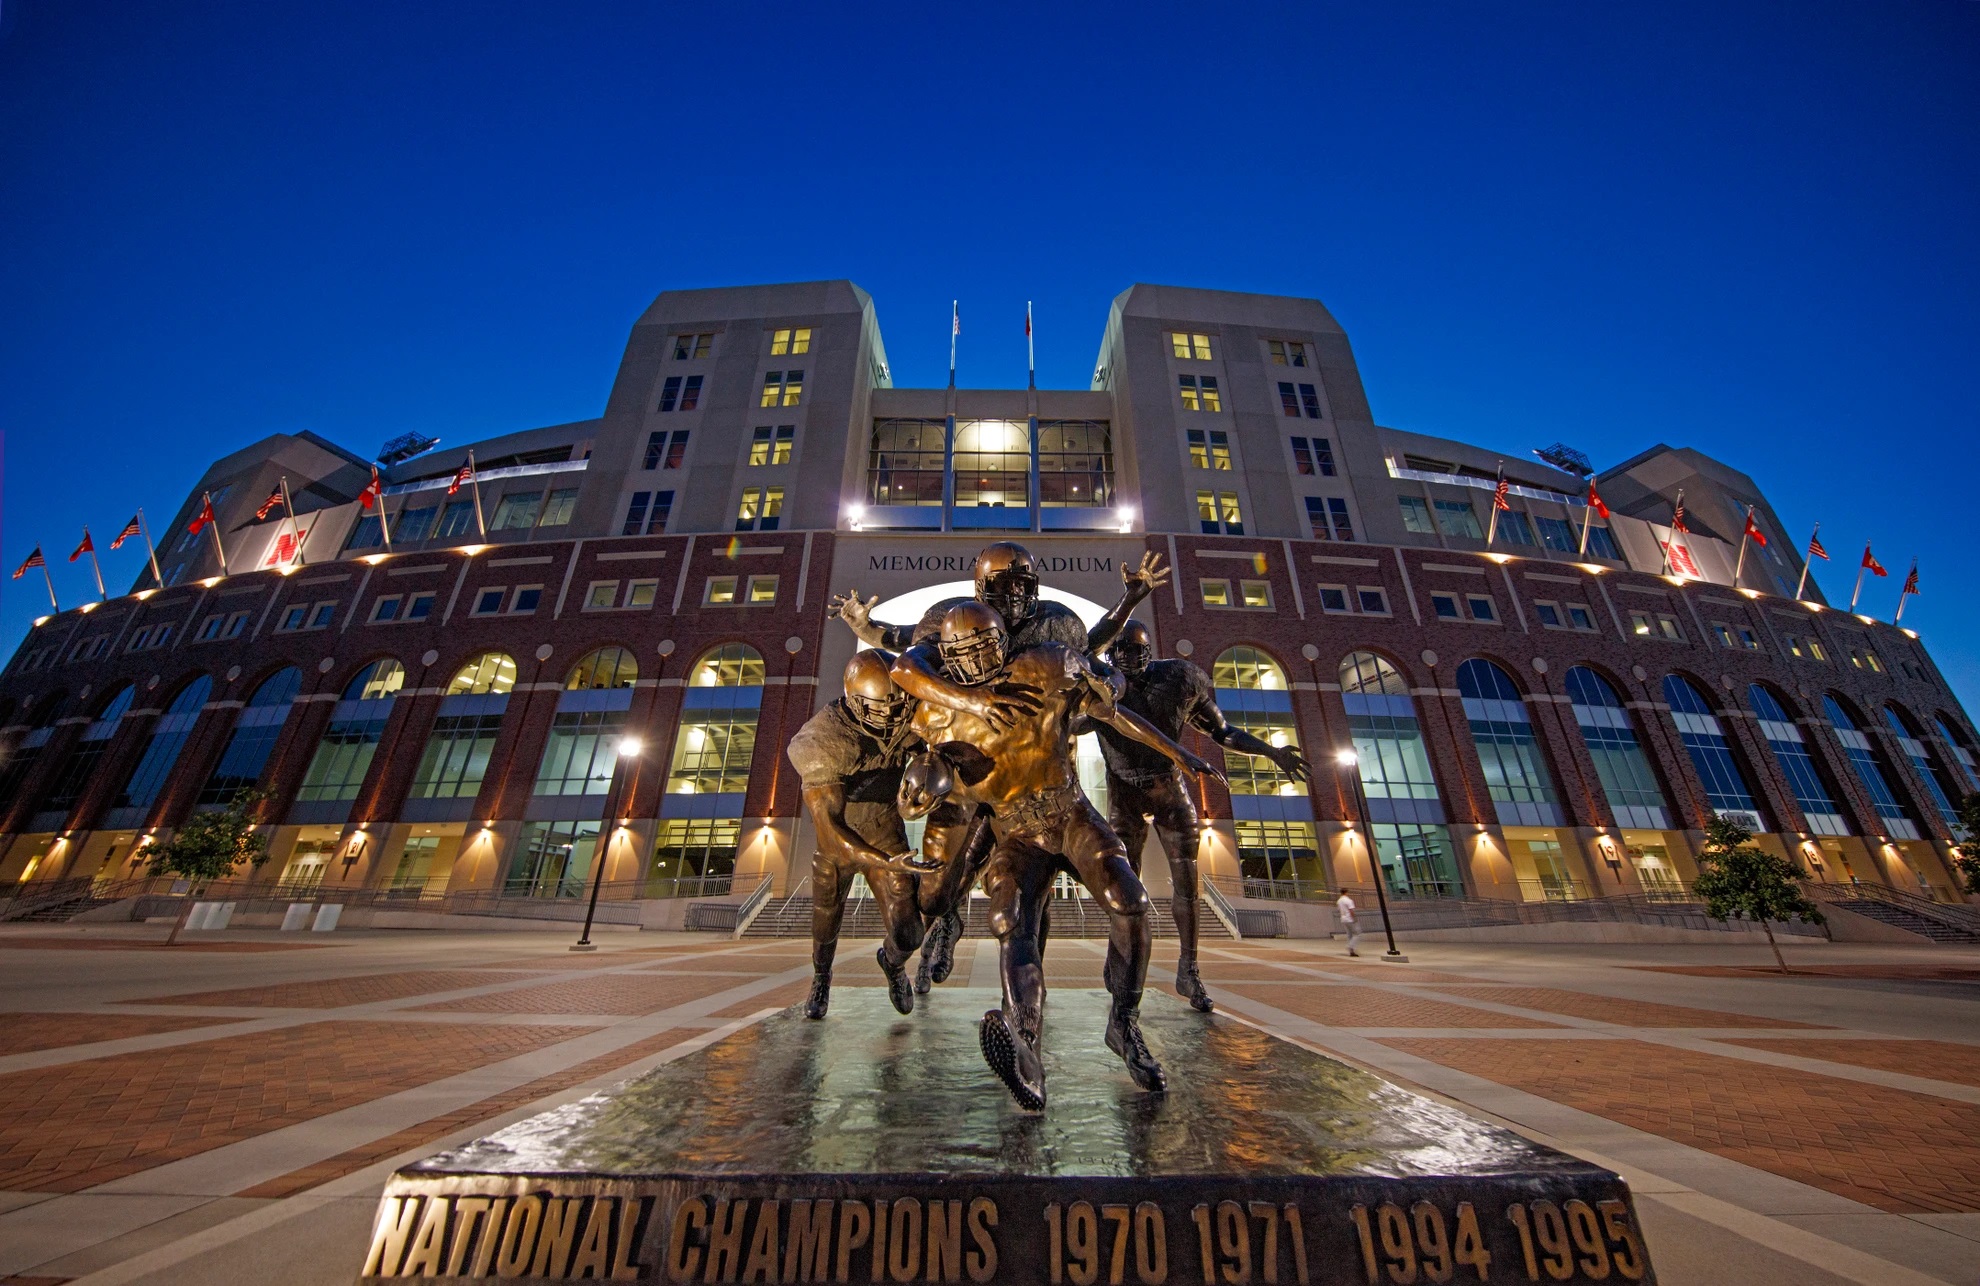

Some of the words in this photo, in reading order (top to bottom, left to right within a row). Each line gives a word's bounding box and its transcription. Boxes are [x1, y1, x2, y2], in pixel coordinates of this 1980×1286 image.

[868, 555, 977, 571] MEMORIA
[1034, 556, 1113, 573] ADIUM
[361, 1195, 640, 1280] NATIONAL
[667, 1196, 999, 1284] CHAMPIONS
[1043, 1200, 1169, 1286] 1970
[1191, 1200, 1310, 1286] 1971
[1349, 1200, 1491, 1285] 1994
[1506, 1199, 1645, 1282] 1995
